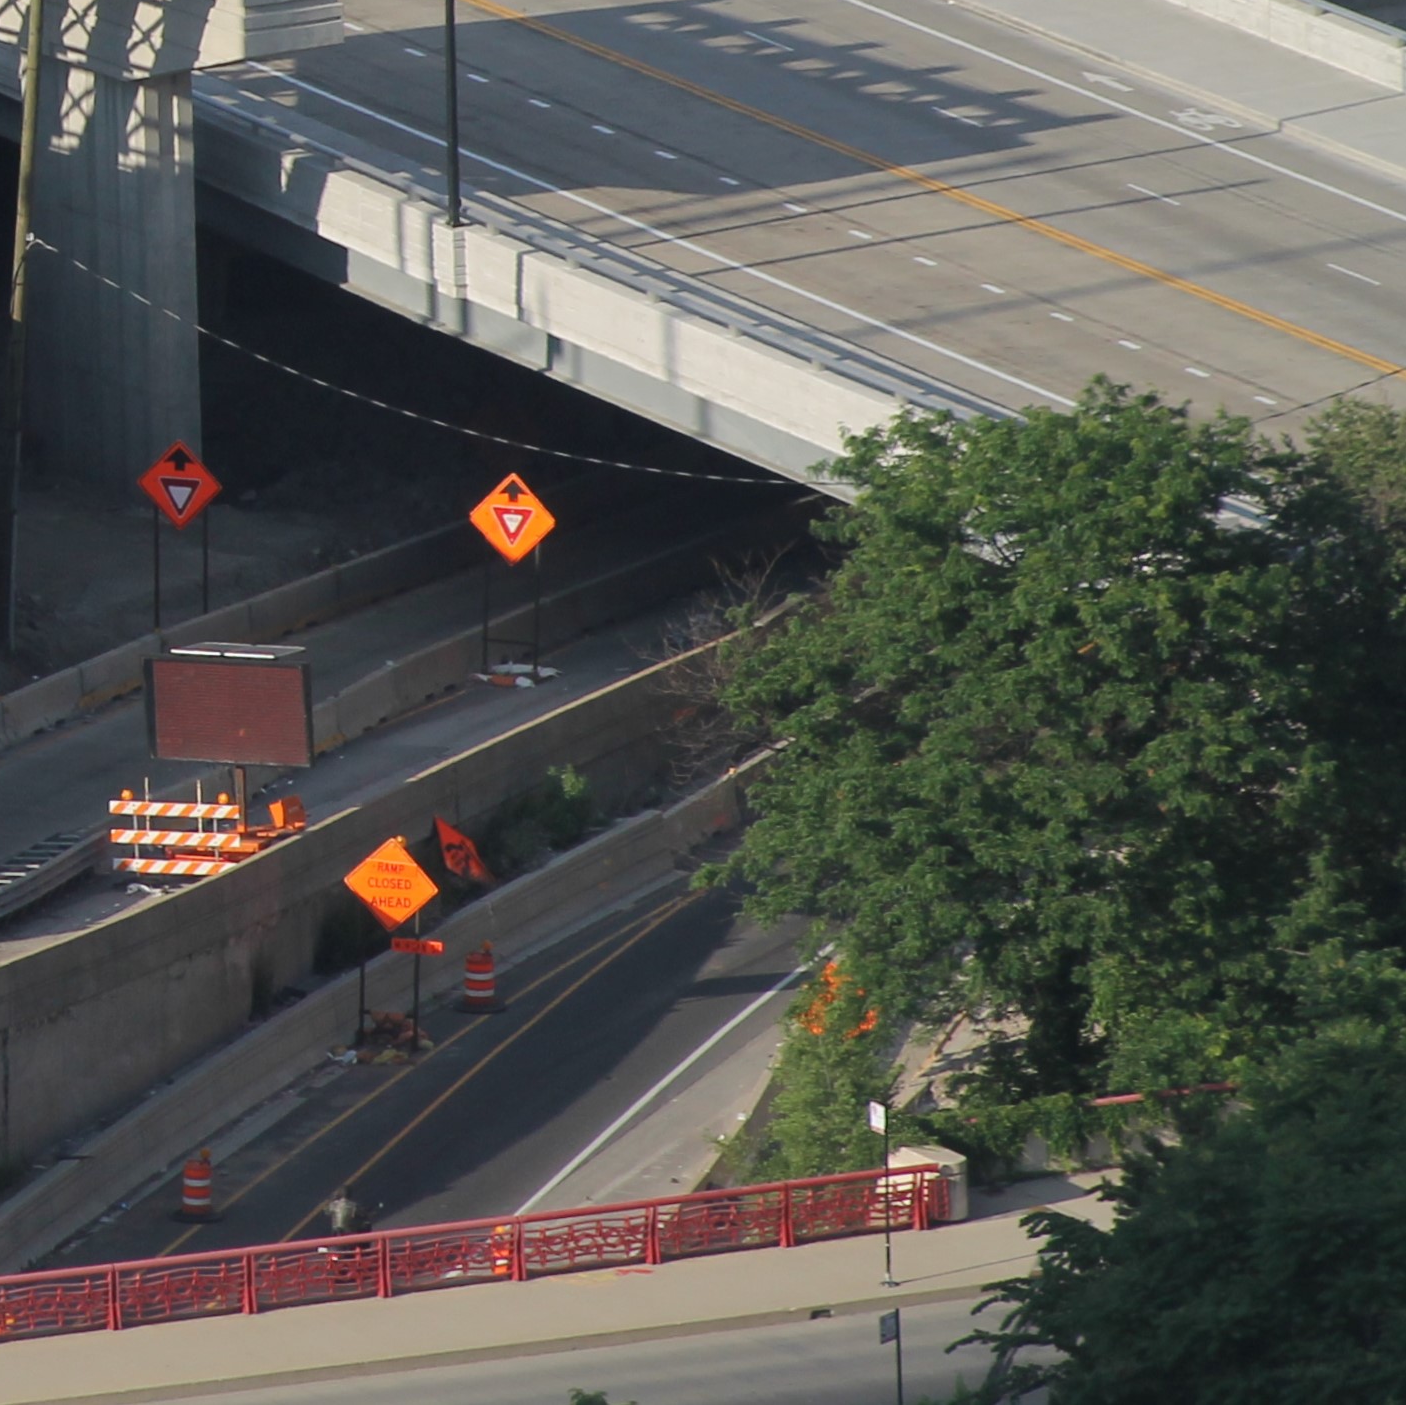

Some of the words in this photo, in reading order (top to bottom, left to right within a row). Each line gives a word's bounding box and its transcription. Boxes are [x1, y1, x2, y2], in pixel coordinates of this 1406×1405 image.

[377, 861, 405, 873] RAMP
[367, 876, 412, 890] CLOSED
[370, 895, 412, 909] AHEAD
